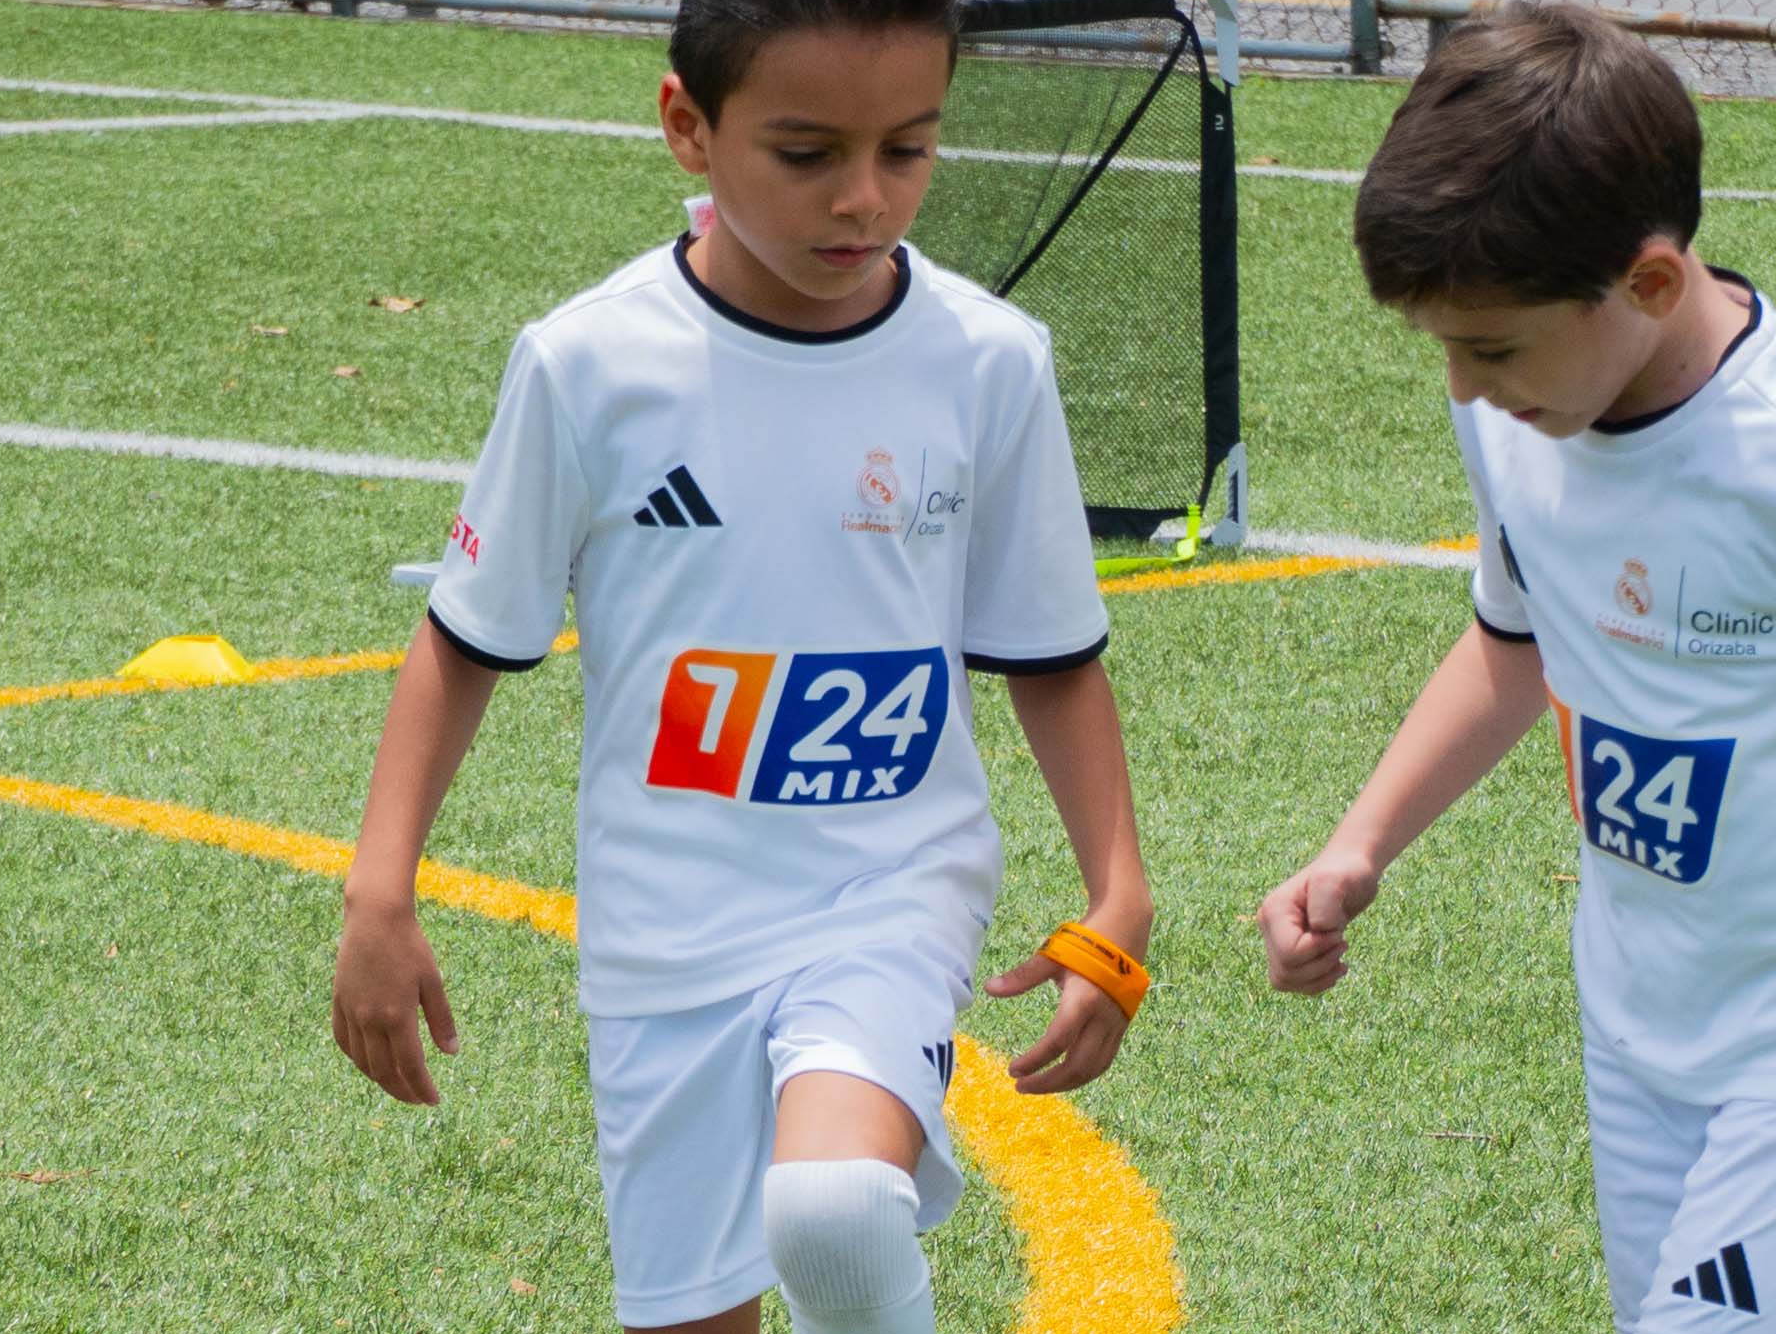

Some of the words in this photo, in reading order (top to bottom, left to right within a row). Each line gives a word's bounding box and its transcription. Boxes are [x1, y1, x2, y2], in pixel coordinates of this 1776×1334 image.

[1690, 610, 1774, 634] Clinic
[1688, 638, 1756, 656] Orizaba
[789, 663, 929, 762] 24
[777, 766, 906, 801] MIX
[1592, 738, 1700, 844] 24
[1598, 821, 1685, 878] MIX
